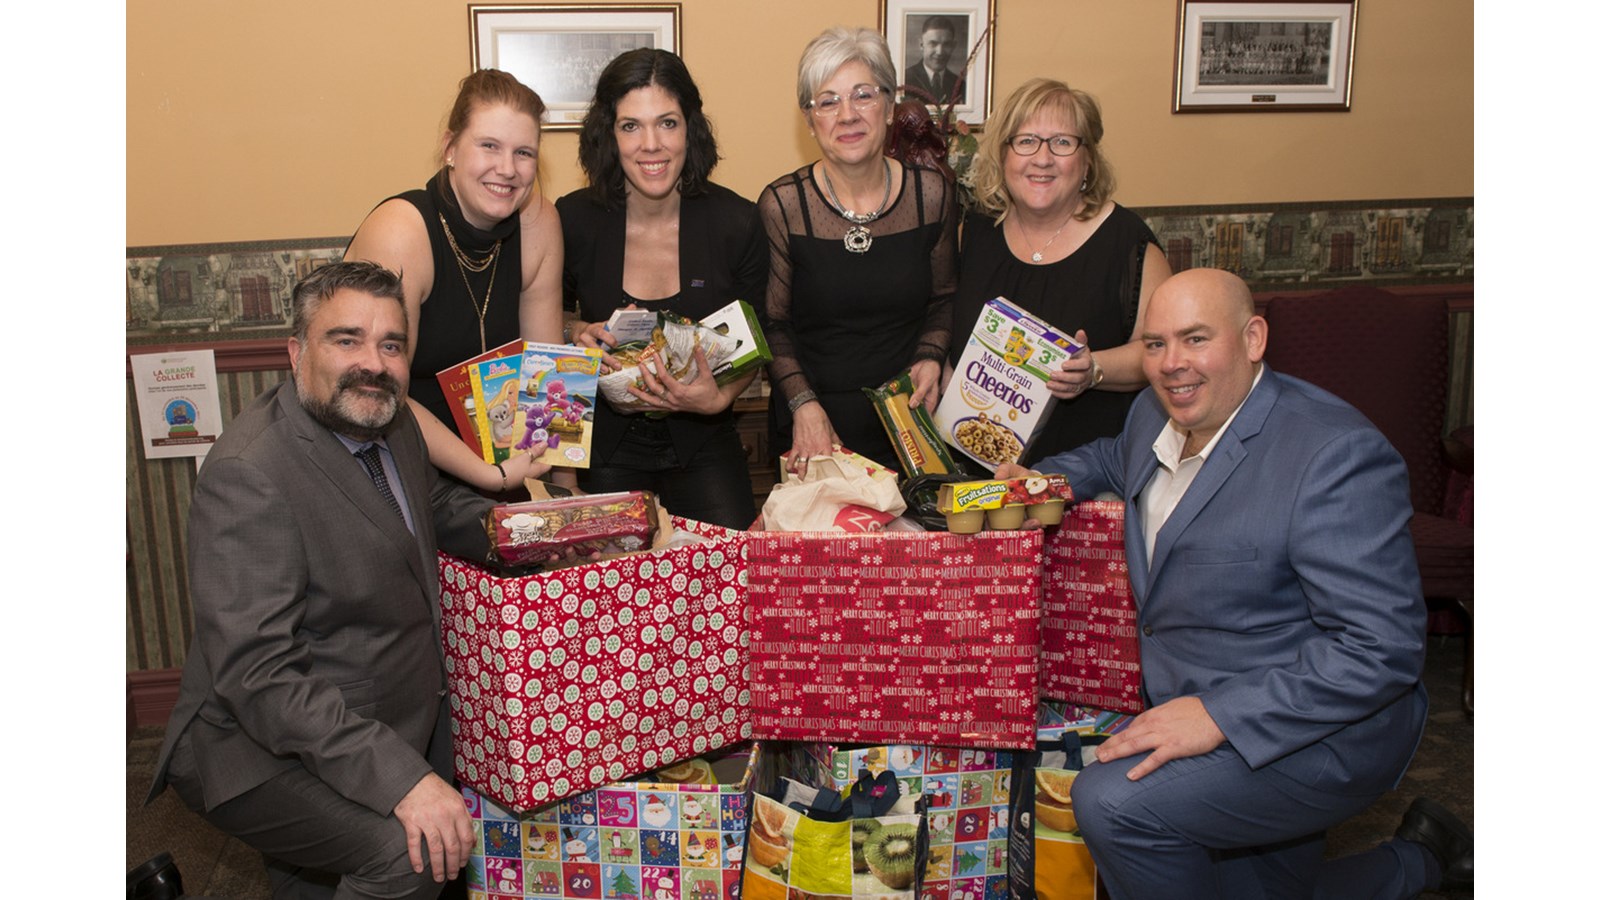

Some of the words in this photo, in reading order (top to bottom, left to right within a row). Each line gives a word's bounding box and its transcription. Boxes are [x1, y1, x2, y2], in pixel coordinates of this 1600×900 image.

[988, 308, 1006, 324] Save
[165, 366, 195, 375] GRANDE
[156, 372, 195, 382] COLLECTE
[962, 381, 970, 391] 5
[966, 360, 1035, 414] Cheerios
[902, 432, 922, 466] PRIMO
[957, 484, 1007, 507] Fruitsations
[978, 495, 1000, 505] original
[801, 585, 818, 595] MERRY
[819, 585, 846, 594] CHRISTMAS
[882, 587, 899, 596] MERRY
[900, 586, 928, 596] CHRISTMAS
[974, 585, 990, 595] MERRY
[991, 585, 1020, 595] CHRISTMAS
[762, 608, 778, 617] MERRY
[779, 608, 807, 617] CHRISTMAS
[842, 610, 858, 618] MERRY
[858, 610, 887, 619] CHRISTMAS
[763, 660, 778, 669] MERRY
[780, 661, 807, 670] CHRISTMAS
[842, 662, 858, 671] MERRY
[858, 663, 886, 672] CHRISTMAS
[802, 684, 818, 693] MERRY
[818, 685, 846, 694] CHRISTMAS
[881, 687, 897, 696] MERRY
[898, 687, 926, 697] CHRISTMAS
[974, 688, 989, 697] MERRY
[990, 688, 1018, 697] CHRISTMAS
[836, 761, 848, 779] 10
[601, 795, 634, 824] 25
[503, 822, 519, 837] 14
[965, 816, 975, 833] 20
[587, 829, 596, 840] 2
[660, 831, 677, 845] 14
[548, 845, 558, 859] 3
[487, 858, 503, 869] 22
[708, 852, 718, 867] 3
[527, 861, 535, 874] 6
[606, 866, 612, 878] 1
[643, 868, 660, 879] 22
[685, 869, 693, 882] 6
[572, 878, 591, 889] 20
[936, 883, 949, 891] 8
[973, 878, 984, 893] 22
